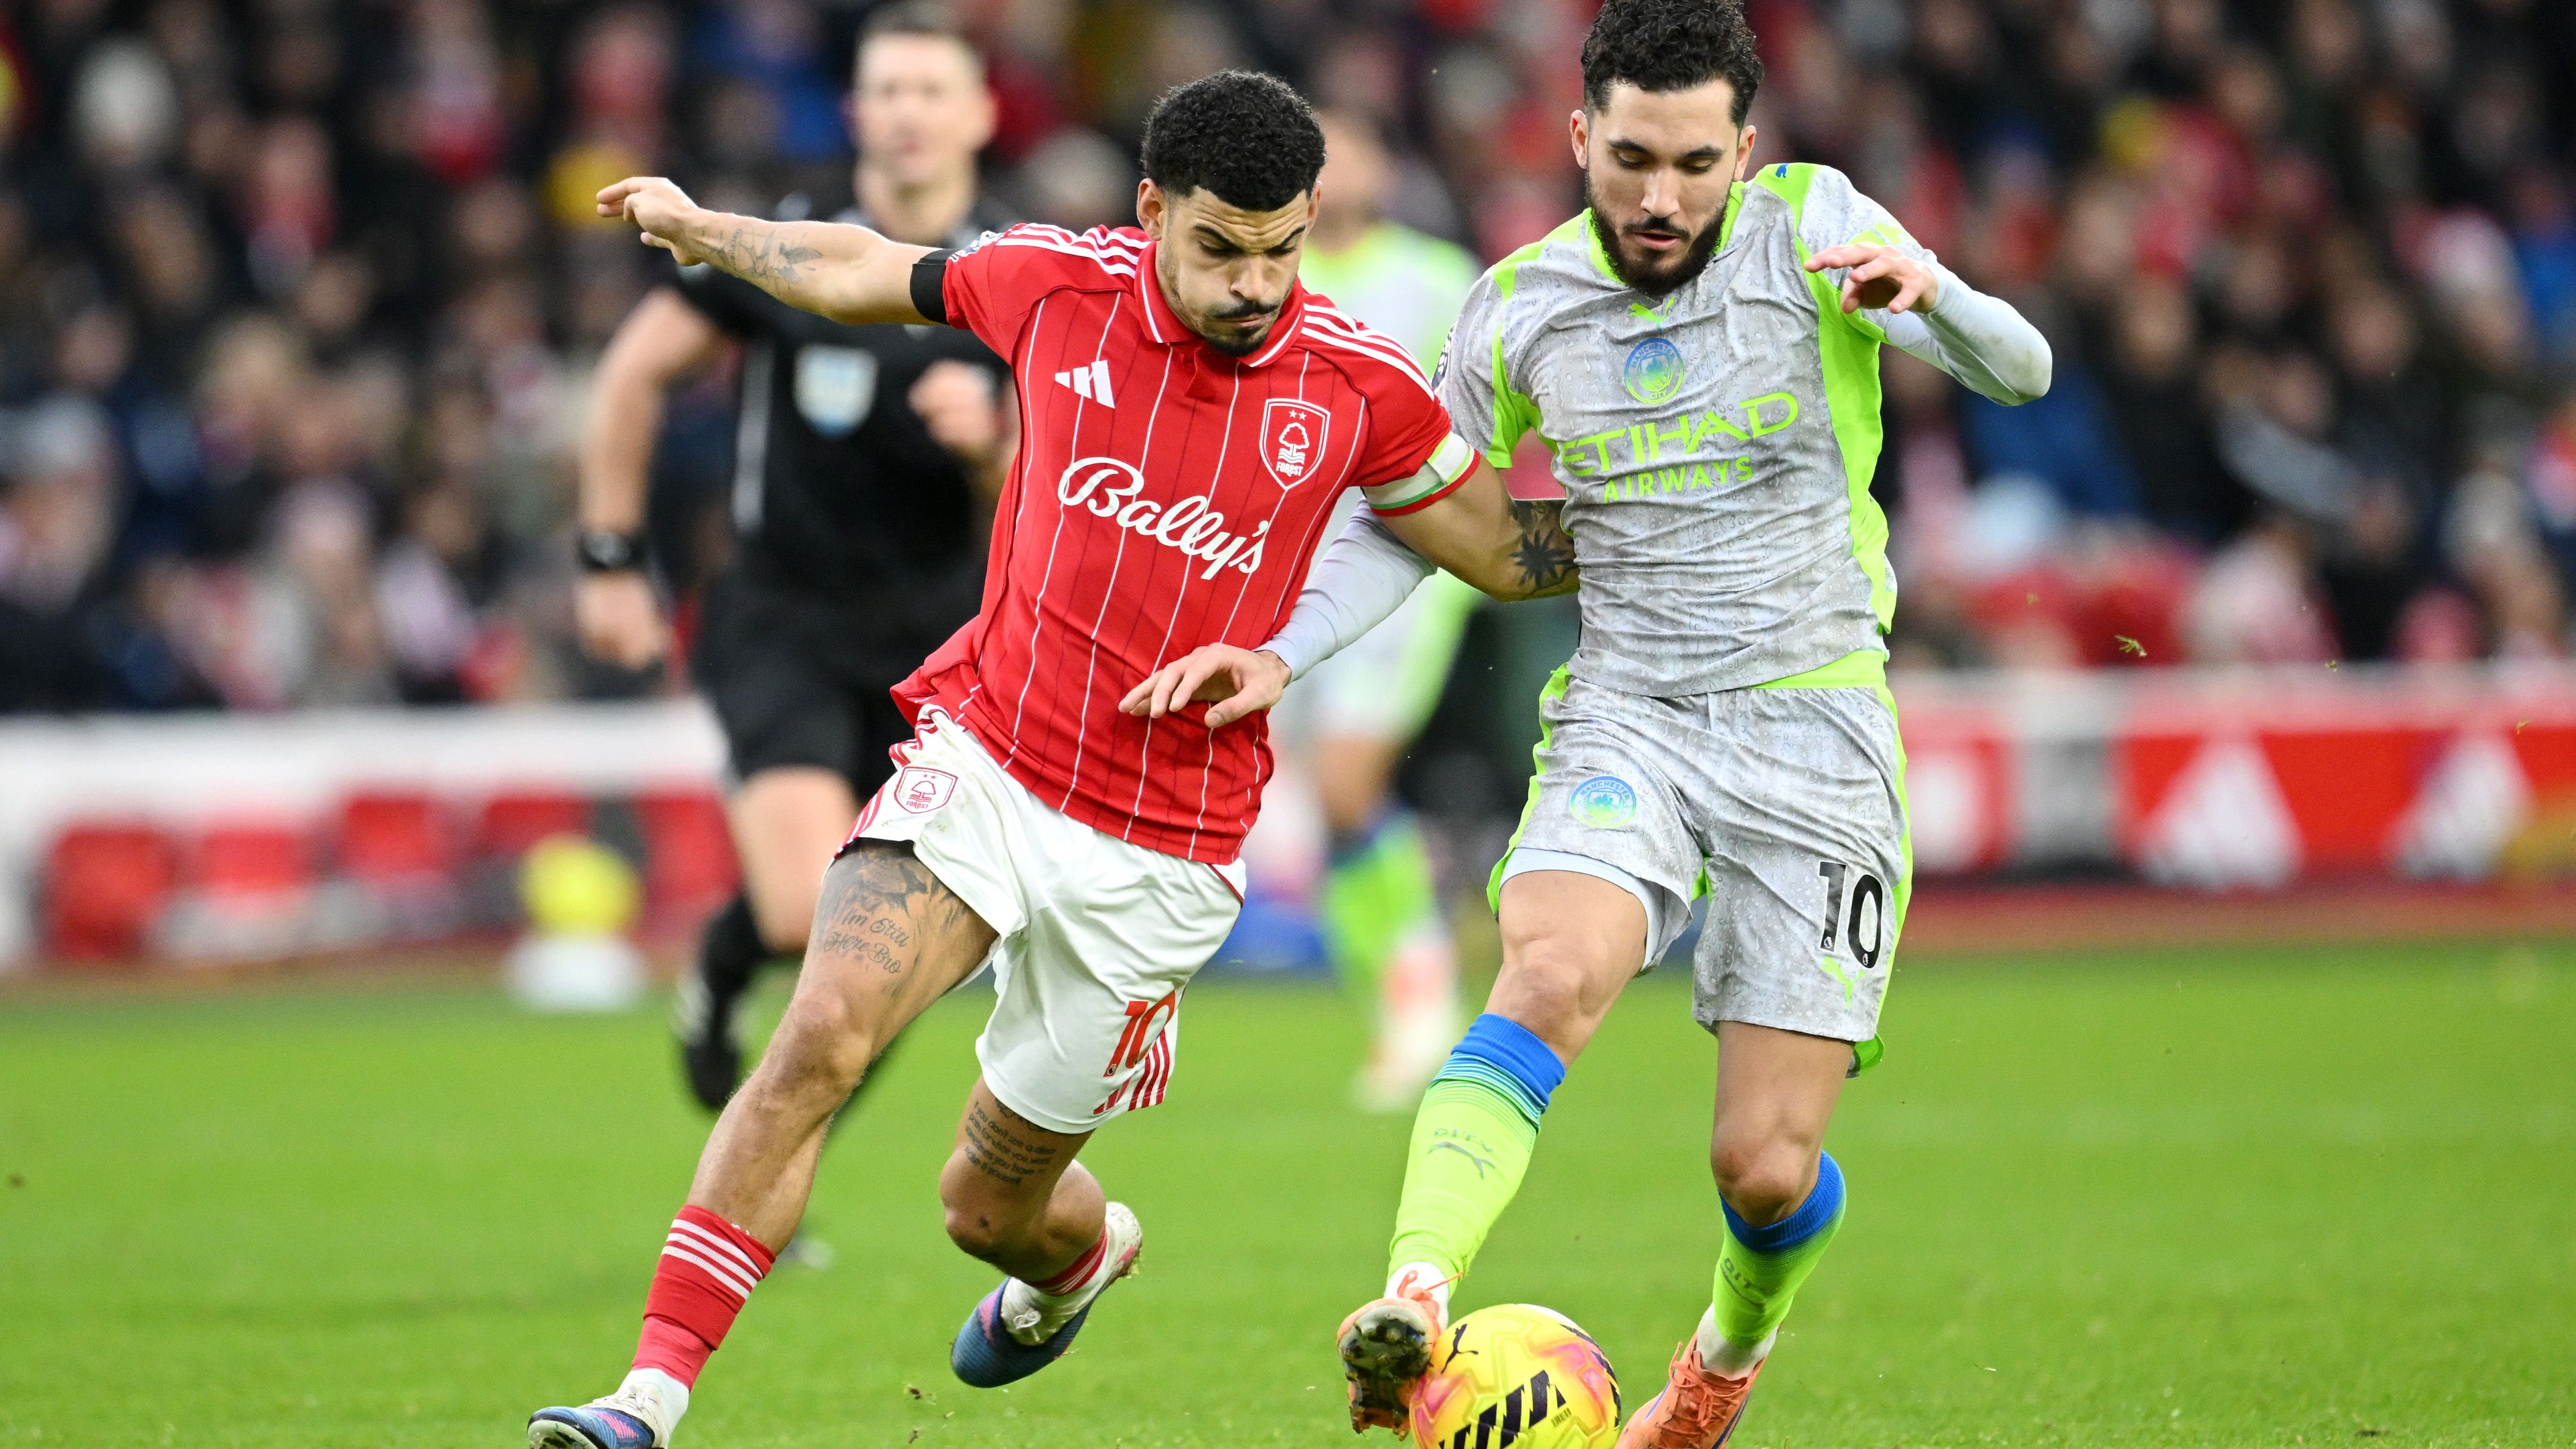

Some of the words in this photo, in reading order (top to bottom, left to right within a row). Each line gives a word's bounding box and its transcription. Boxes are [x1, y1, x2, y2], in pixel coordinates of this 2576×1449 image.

[1650, 390, 1667, 400] CITY
[1562, 392, 1799, 477] ETIHAD
[1603, 456, 1754, 504] AIRWAYS
[1057, 457, 1270, 581] Bally's
[1580, 780, 1630, 799] MANCHESTER
[1819, 860, 1883, 969] 10
[868, 943, 901, 974] Bro
[1104, 990, 1176, 1077] 10
